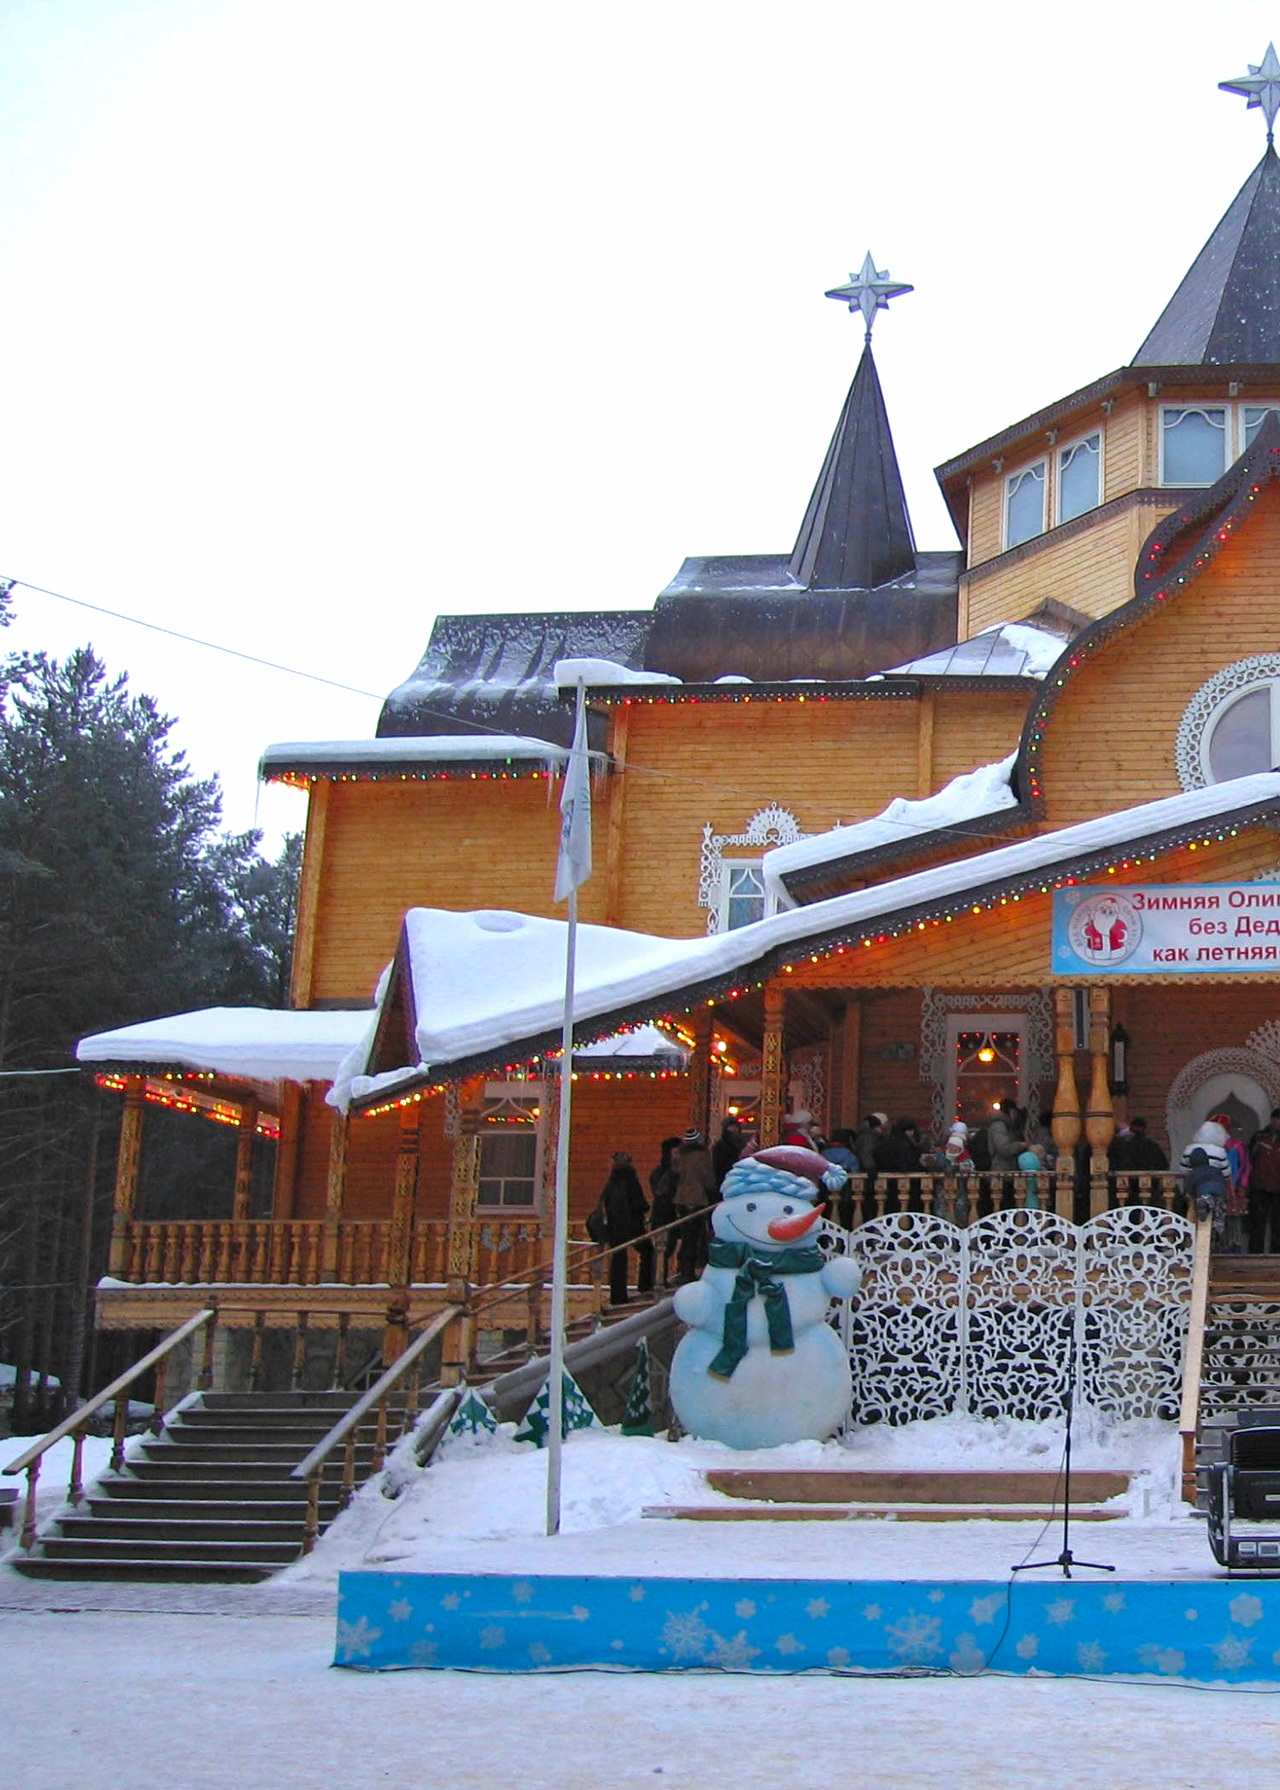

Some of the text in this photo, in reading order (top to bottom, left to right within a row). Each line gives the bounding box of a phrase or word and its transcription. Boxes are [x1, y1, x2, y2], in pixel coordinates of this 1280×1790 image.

[1131, 892, 1220, 911] Зимняя
[1188, 917, 1228, 935] без
[1152, 947, 1189, 962] как
